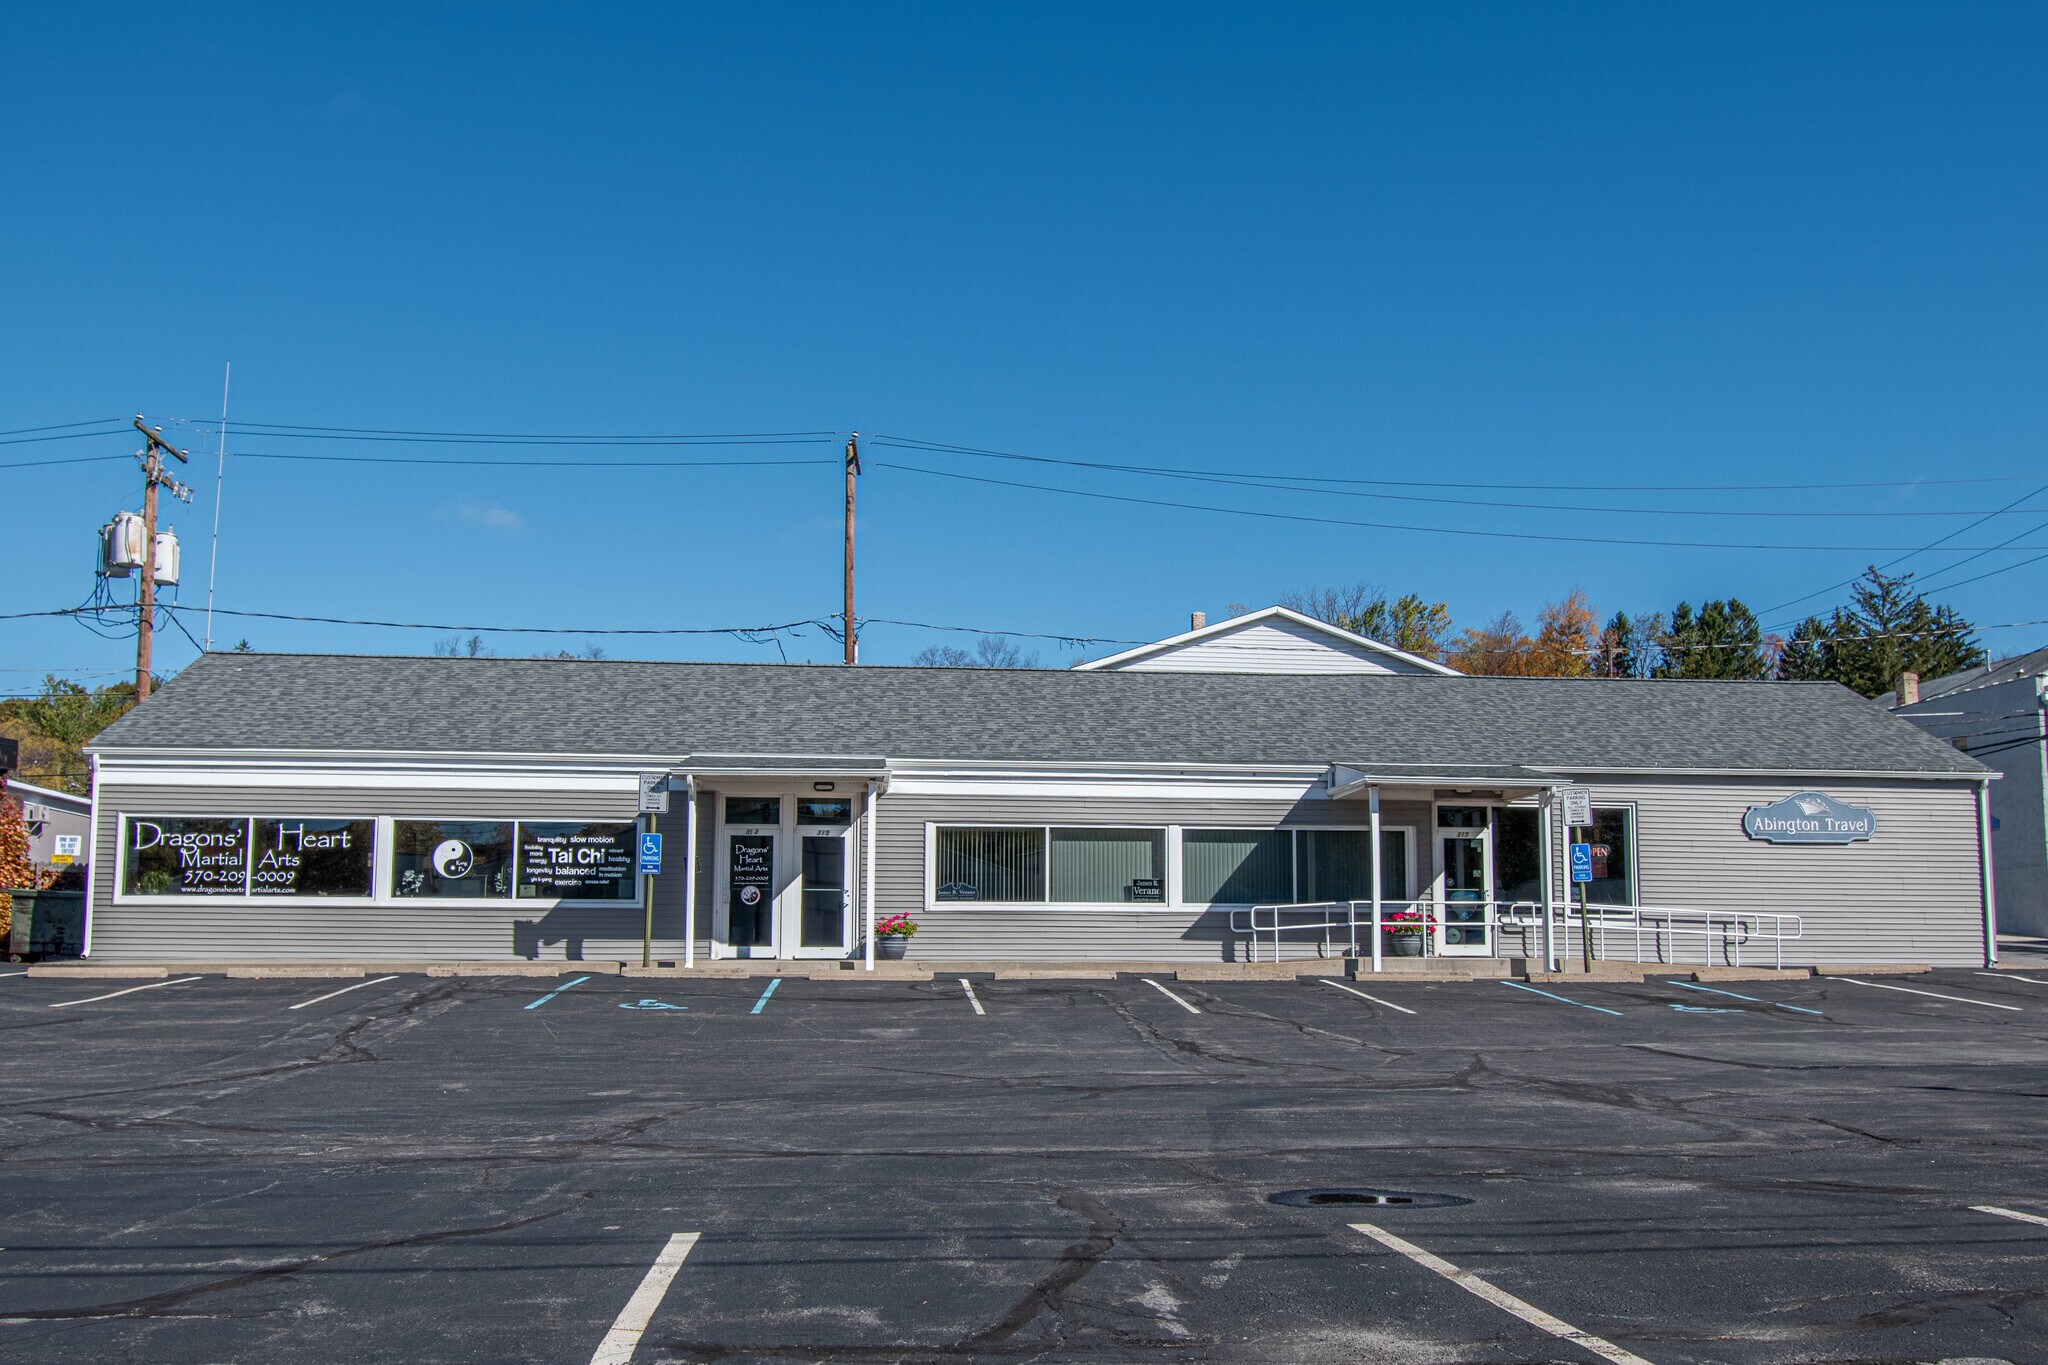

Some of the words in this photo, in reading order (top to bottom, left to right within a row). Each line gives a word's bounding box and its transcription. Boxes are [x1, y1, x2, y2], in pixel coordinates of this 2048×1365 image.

[1754, 817, 1820, 834] Abington
[1825, 818, 1868, 832] Travel
[134, 822, 242, 854] Dragons'
[278, 823, 352, 851] Heart
[537, 836, 567, 844] tranquility
[735, 844, 769, 856] Dragons'
[1590, 847, 1608, 856] PEN
[181, 848, 242, 868] Martial
[258, 849, 300, 868] Arts
[548, 848, 573, 864] Tai
[577, 848, 605, 864] Chi
[740, 854, 763, 864] Heart
[526, 866, 552, 874] longevity
[555, 866, 596, 875] balanced
[1134, 886, 1161, 895] Verano
